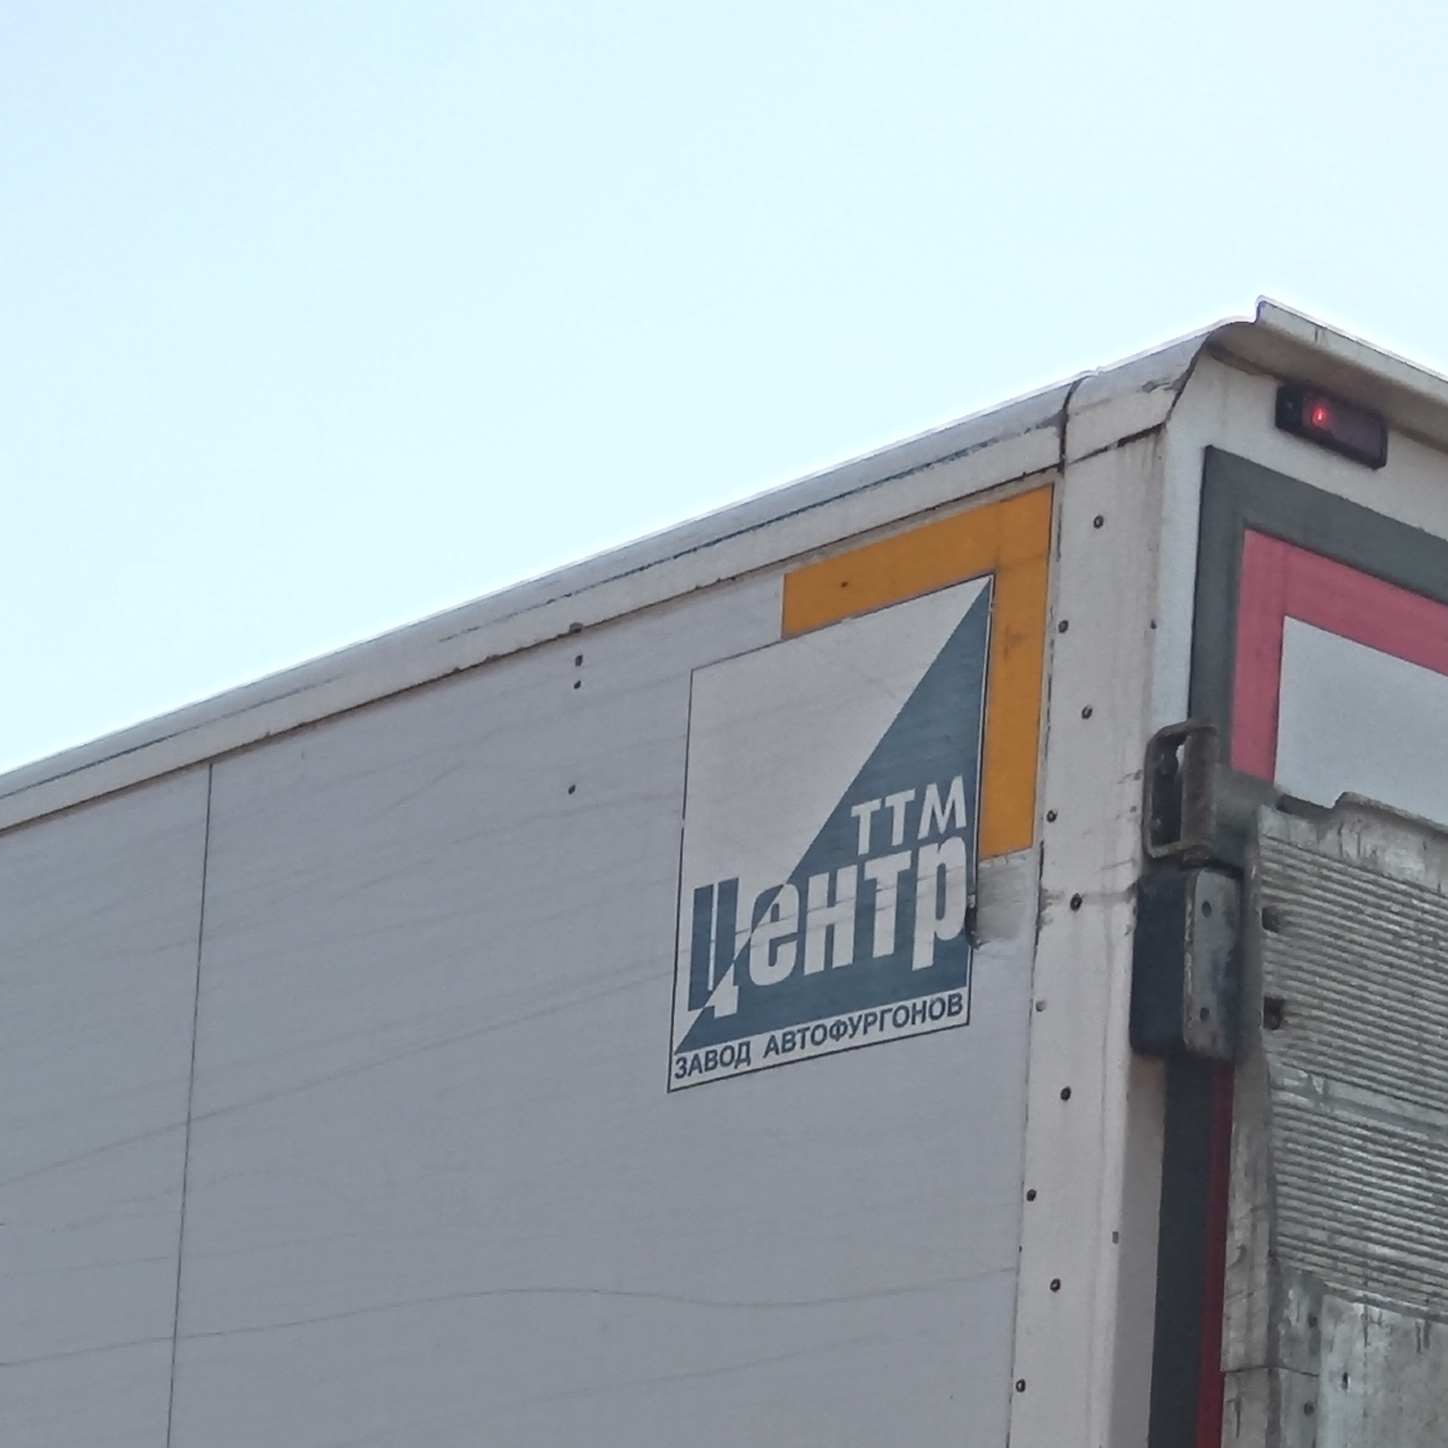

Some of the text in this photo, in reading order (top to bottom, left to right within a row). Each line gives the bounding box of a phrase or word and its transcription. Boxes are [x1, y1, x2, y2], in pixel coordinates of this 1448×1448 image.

[851, 774, 968, 857] ТТМ
[673, 991, 964, 1081] ЗАВОД АВТОФУРГОНОВ
